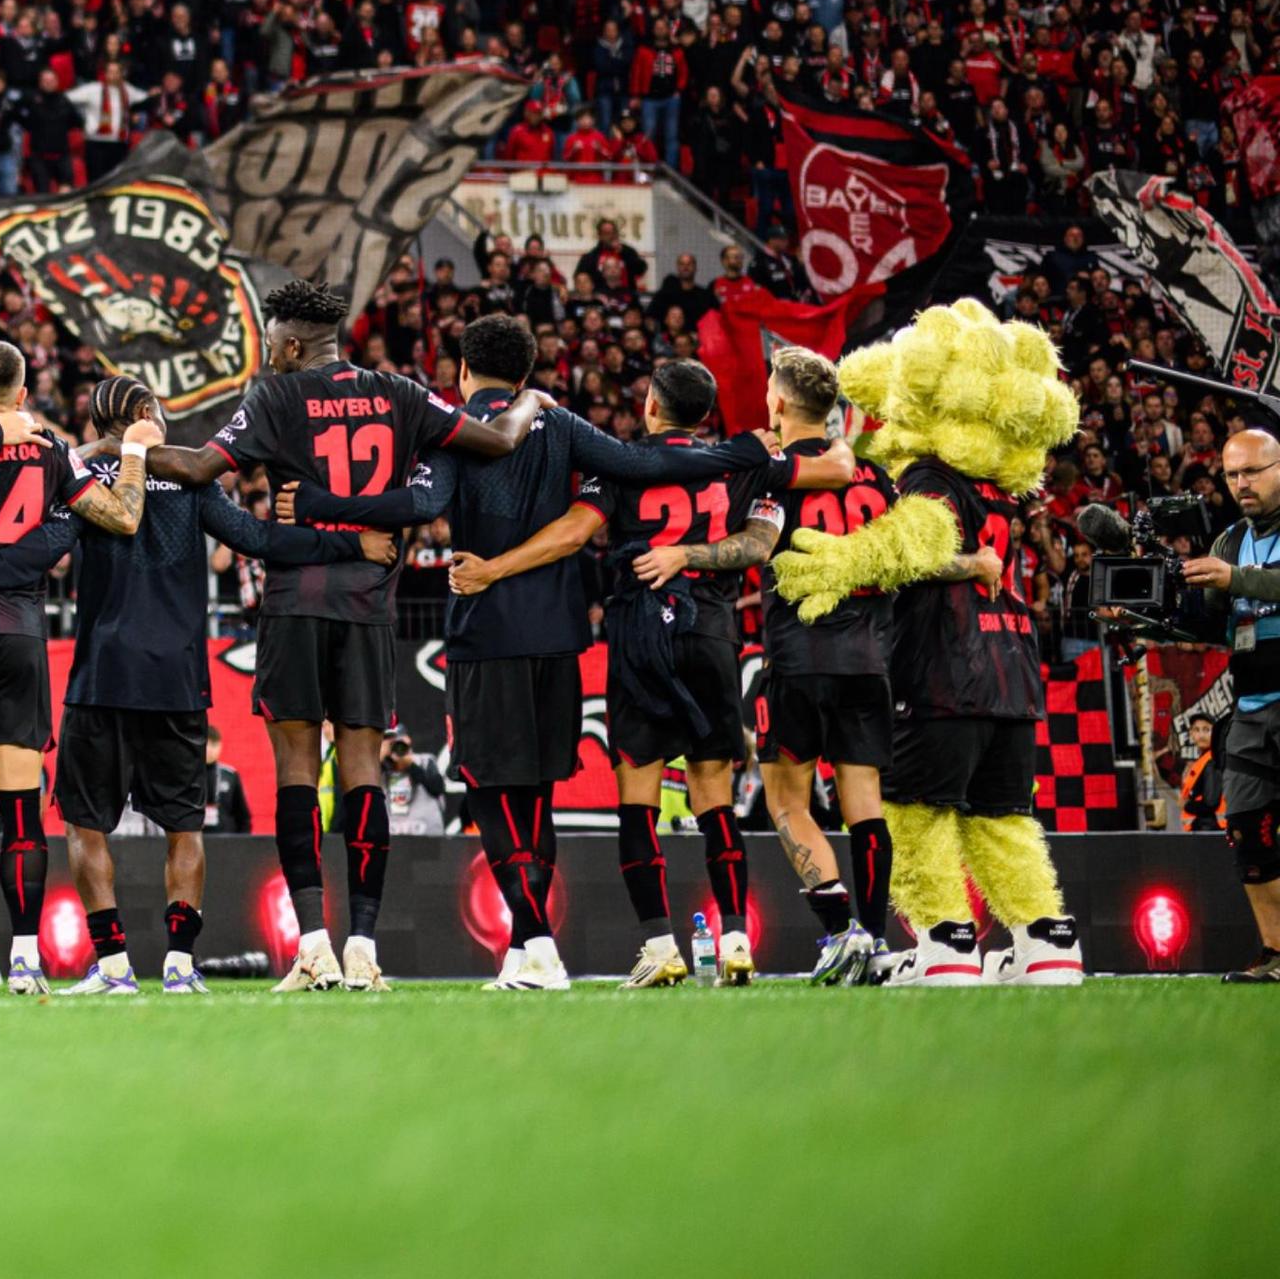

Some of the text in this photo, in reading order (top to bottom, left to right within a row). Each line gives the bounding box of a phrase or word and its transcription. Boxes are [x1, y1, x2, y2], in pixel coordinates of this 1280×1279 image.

[108, 195, 226, 271] 1985
[306, 397, 373, 418] BAYER
[313, 423, 394, 498] 12
[638, 481, 731, 549] 21
